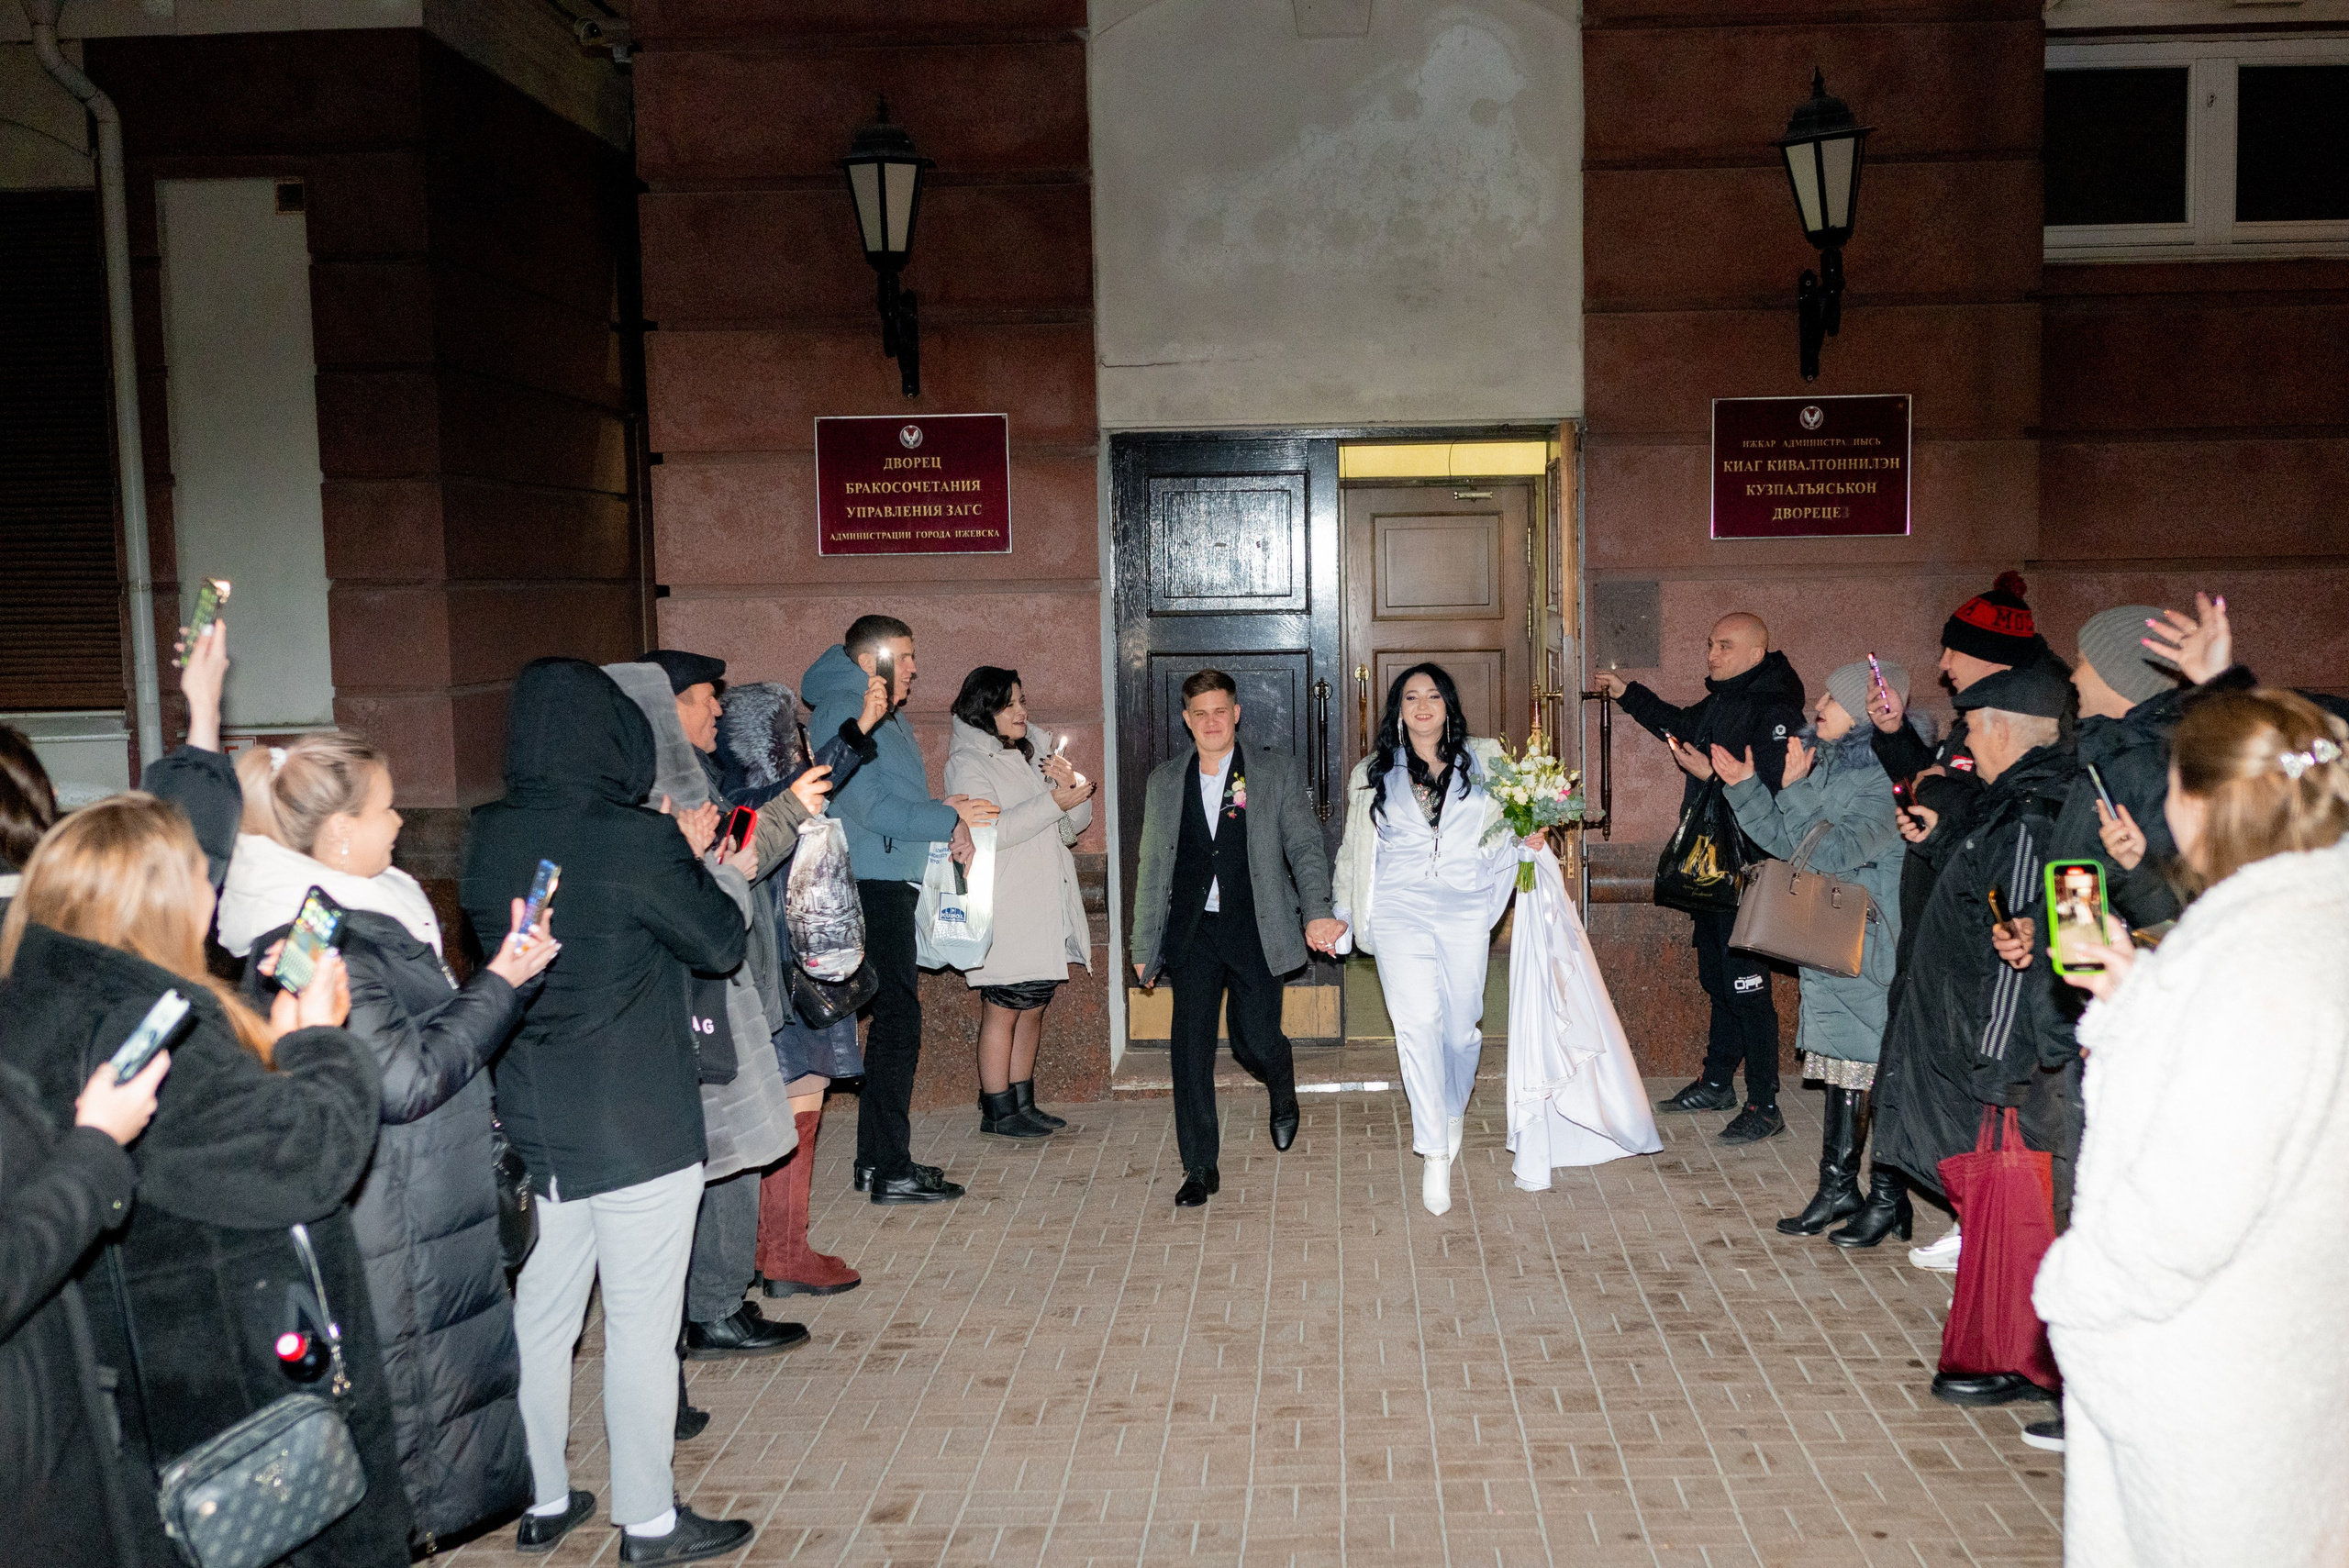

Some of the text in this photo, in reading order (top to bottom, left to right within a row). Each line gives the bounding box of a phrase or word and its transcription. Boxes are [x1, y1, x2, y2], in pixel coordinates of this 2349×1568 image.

[883, 456, 942, 471] ДВОРЕЦ
[1723, 457, 1900, 473] КИАГ КИВАЛТОННИЛЭН
[845, 479, 982, 495] БРАКОСОЧЕТАНИЯ
[1745, 482, 1877, 496] КУЗПАЛЪЯСЬКОН
[846, 504, 983, 518] УПРАВЛЕНИЯ ЗАГС
[829, 528, 1000, 541] АДМИНИСТРАЦИИ ГОРОДА ИЖЕВСКА
